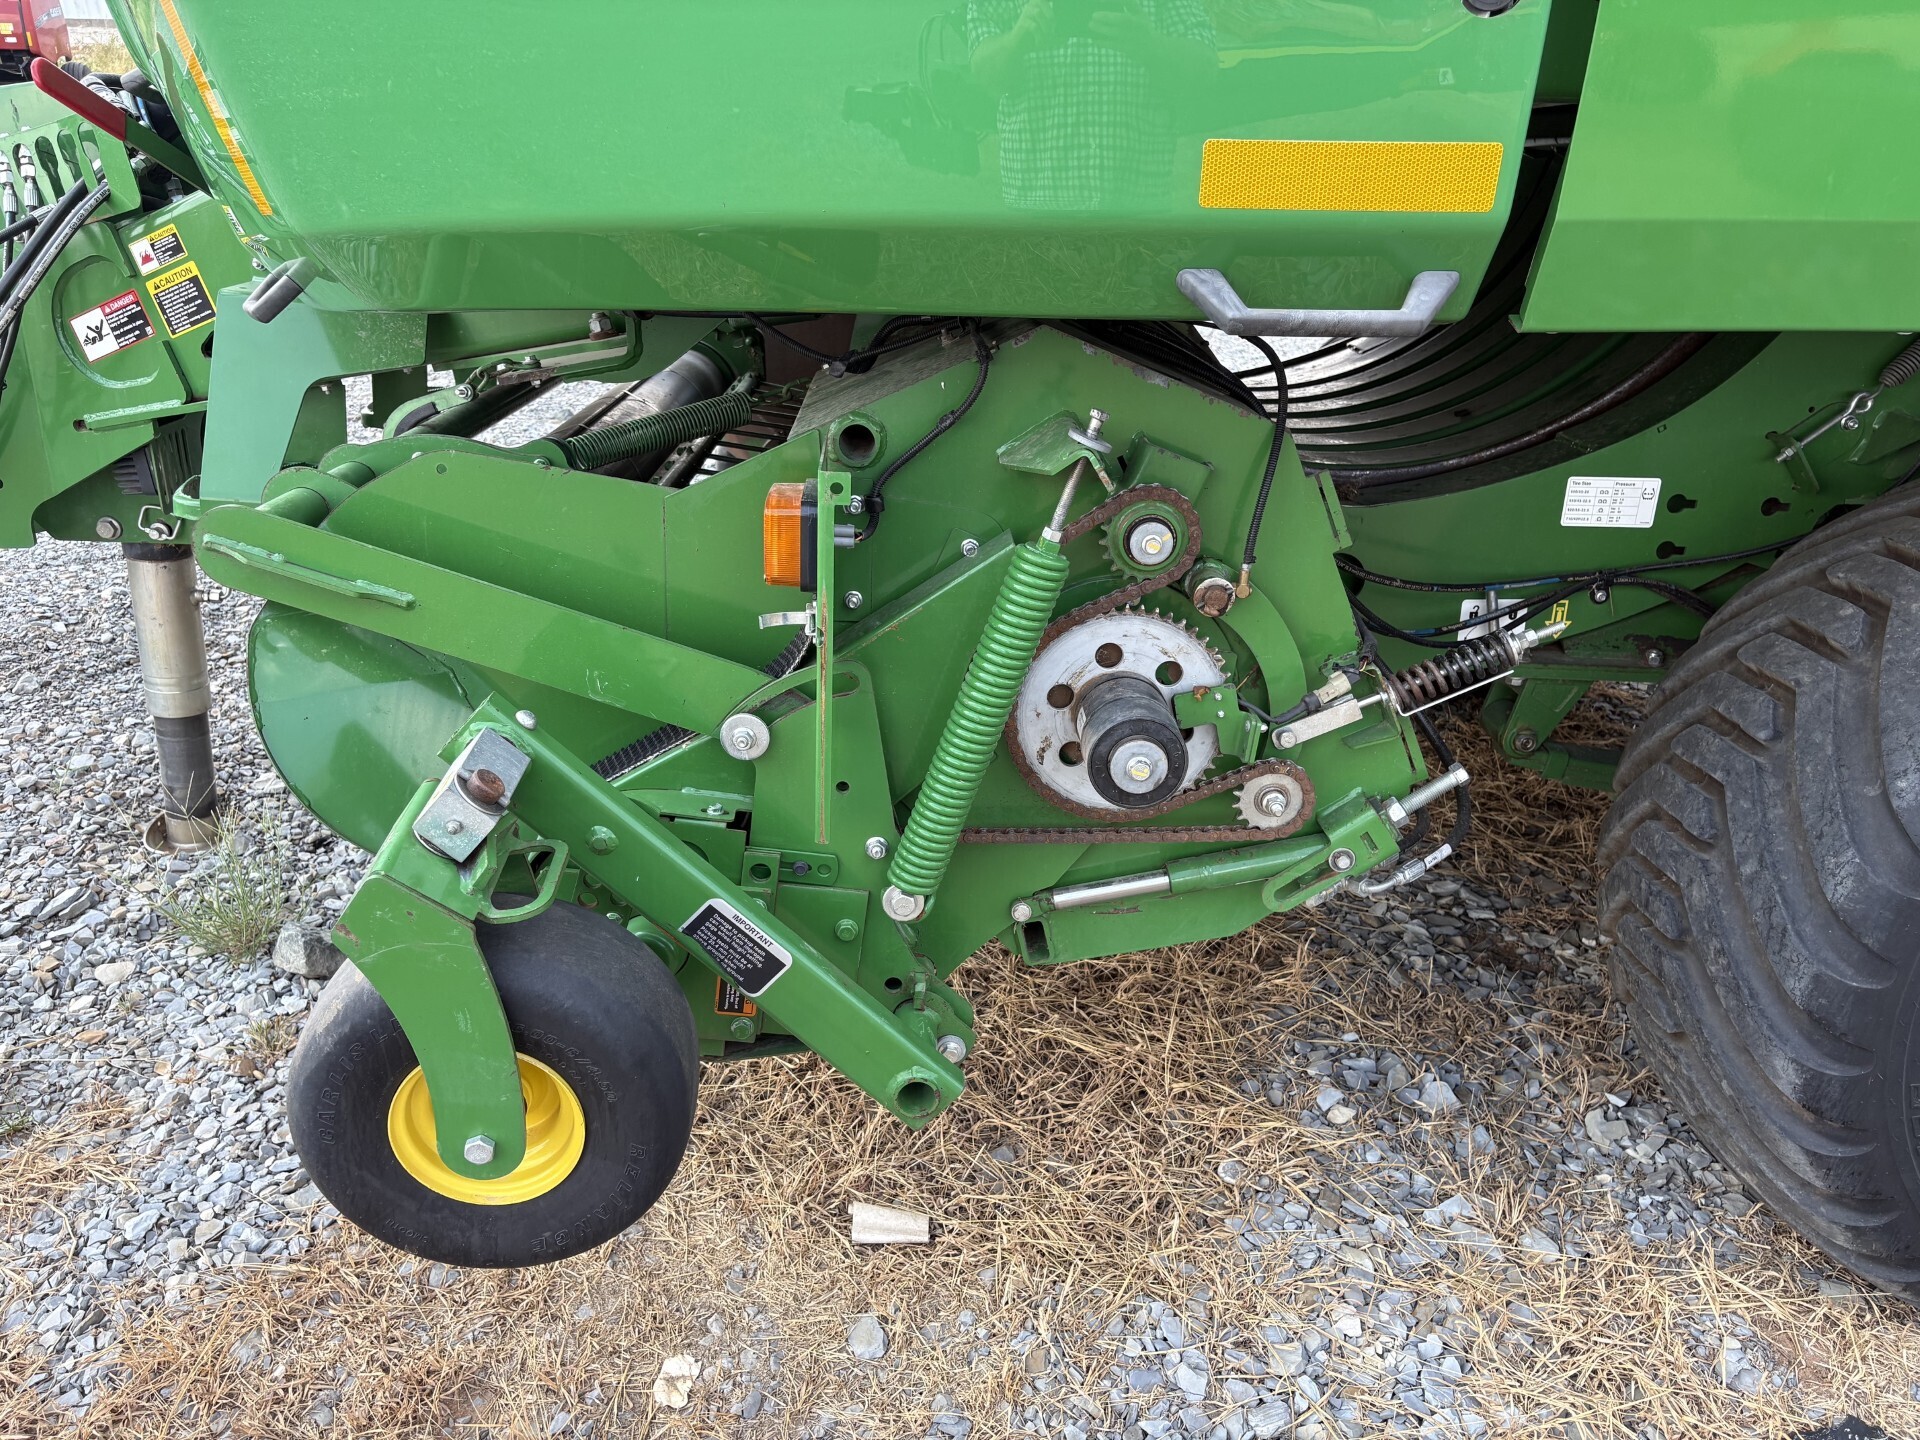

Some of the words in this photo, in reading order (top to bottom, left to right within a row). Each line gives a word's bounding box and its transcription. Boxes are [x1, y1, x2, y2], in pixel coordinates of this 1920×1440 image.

[153, 226, 175, 240] CAUTION
[159, 266, 193, 287] CAUTION
[110, 294, 135, 310] DANGER
[701, 926, 716, 940] Pickup
[717, 939, 728, 949] teeth
[729, 949, 741, 959] must
[714, 914, 732, 929] Damage
[737, 934, 753, 946] pickup
[754, 946, 765, 956] teeth
[719, 925, 732, 936] result
[733, 936, 743, 945] from
[744, 945, 764, 961] improper
[732, 914, 774, 947] IMPORTANT
[697, 930, 708, 940] least
[708, 939, 718, 948] 25.4
[733, 959, 745, 969] inch)
[707, 946, 724, 959] ground
[725, 959, 736, 969] when
[718, 931, 731, 942] wheel
[732, 942, 746, 954] height
[746, 954, 762, 968] setting.
[530, 1142, 647, 1253] RELIANCE
